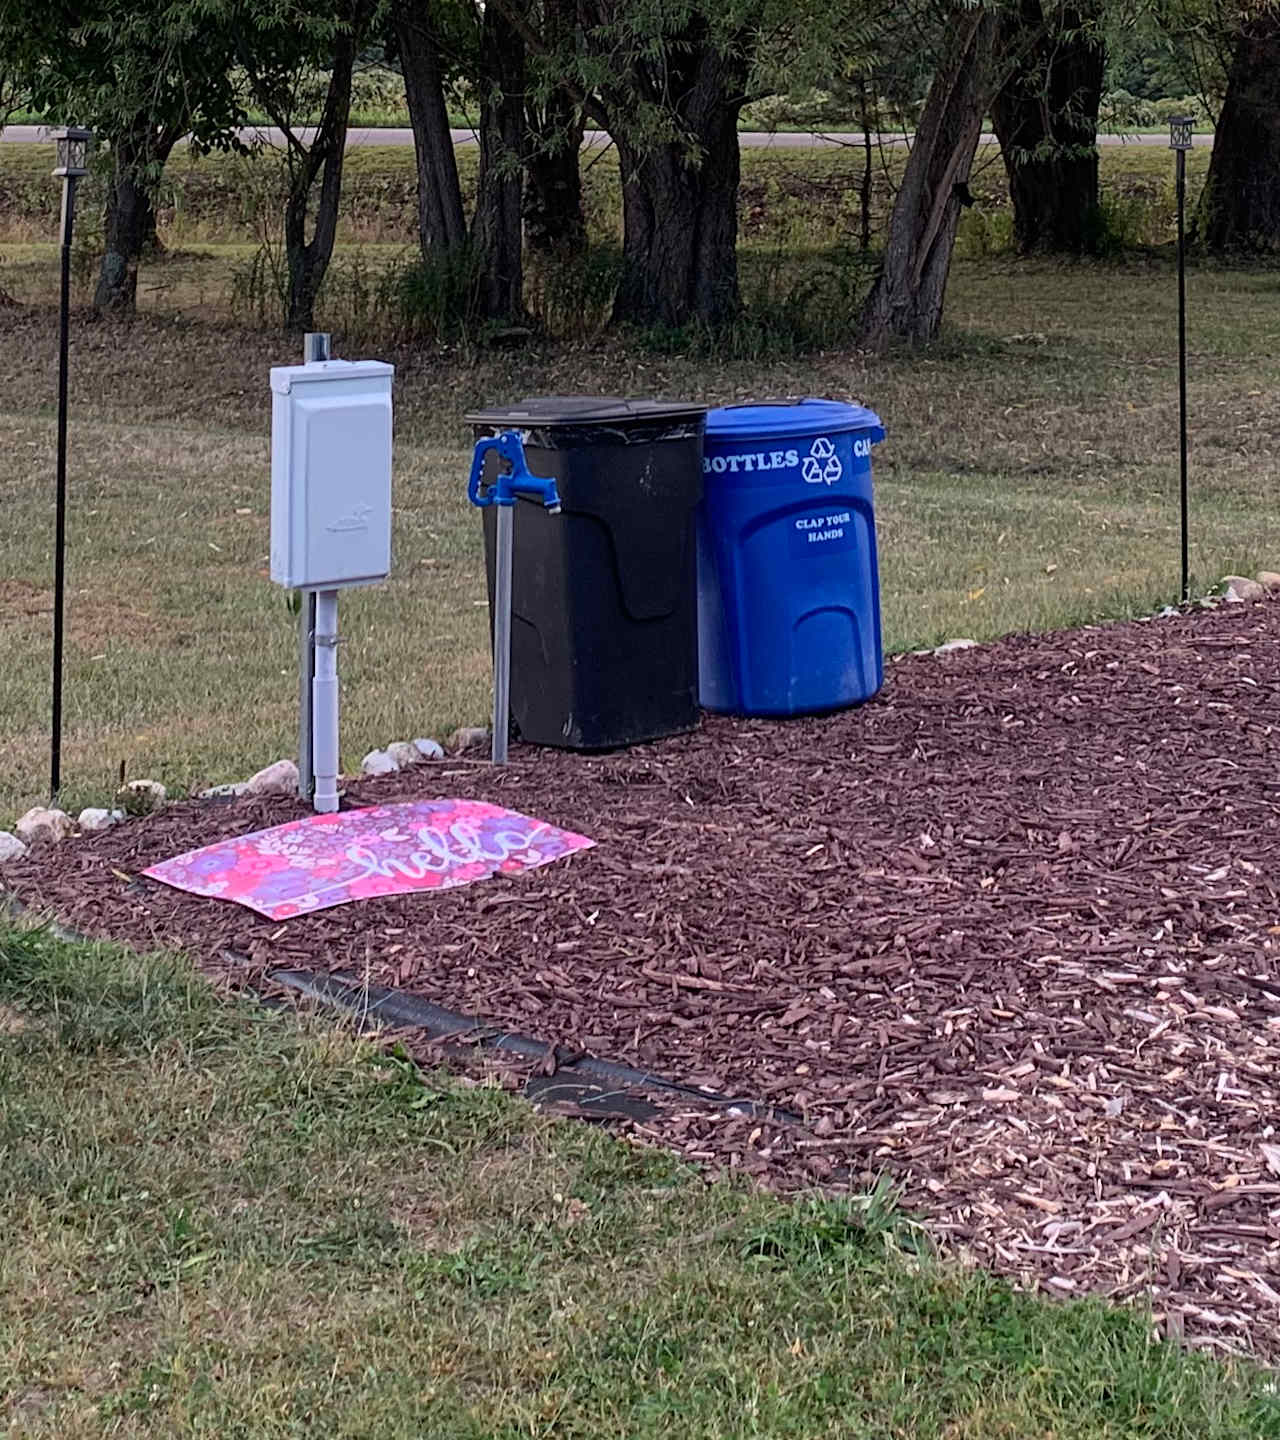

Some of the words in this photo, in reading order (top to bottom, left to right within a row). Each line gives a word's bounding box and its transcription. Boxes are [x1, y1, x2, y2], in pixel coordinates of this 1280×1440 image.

[702, 449, 800, 474] BOTTLES
[795, 517, 825, 529] CLAP
[826, 512, 851, 526] YOUR
[807, 528, 844, 542] HANDS
[332, 822, 549, 881] hello
